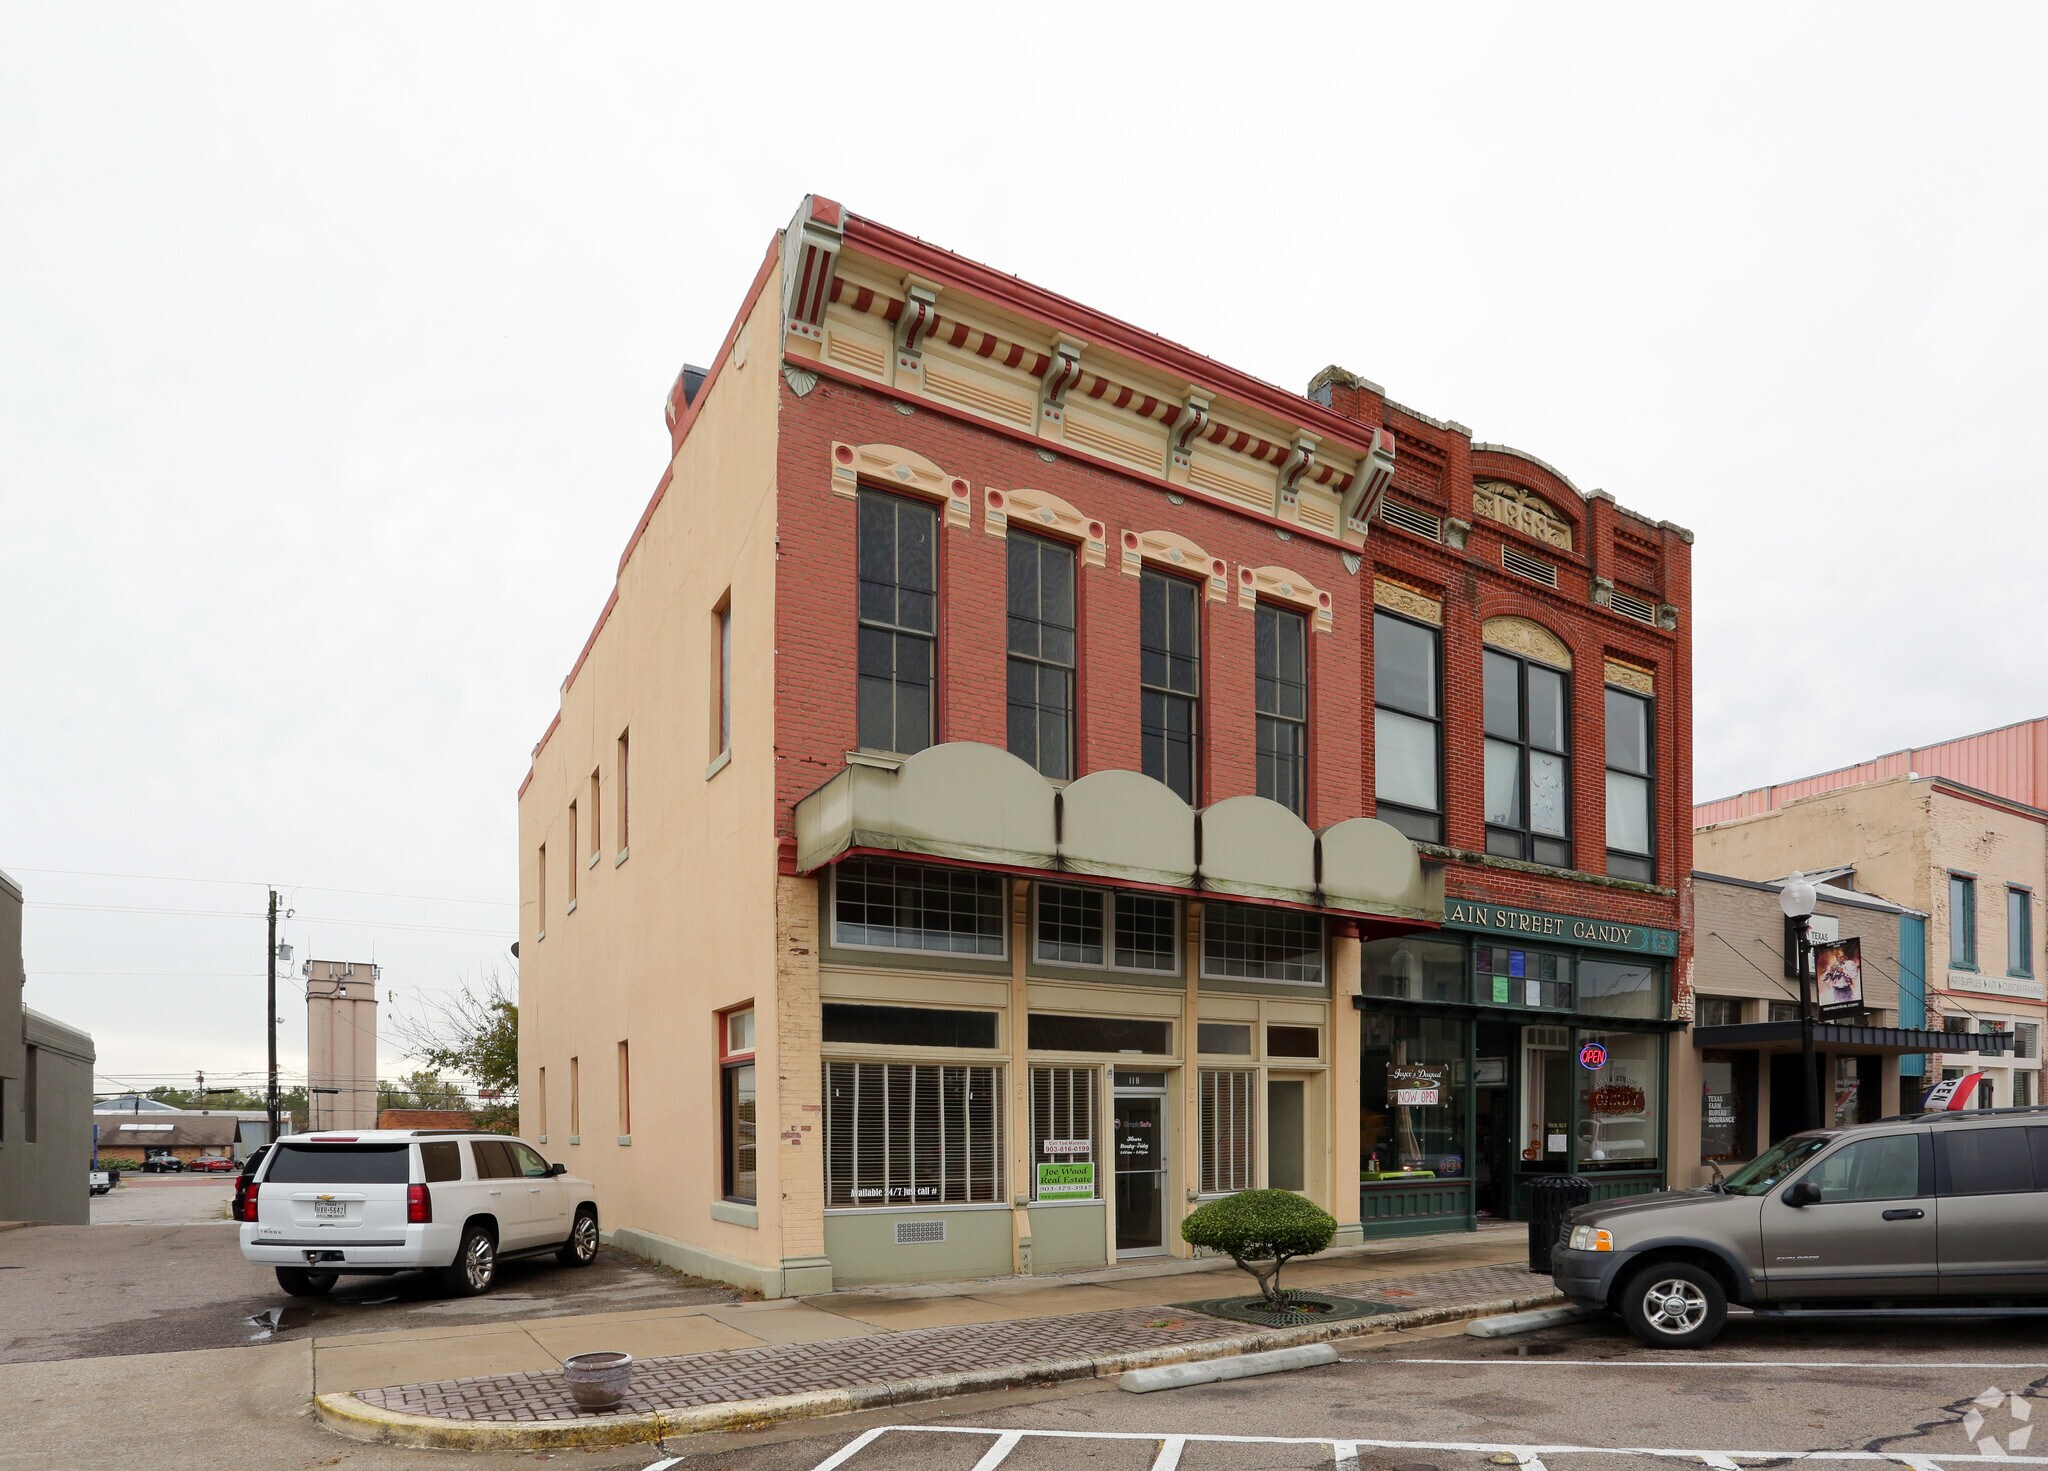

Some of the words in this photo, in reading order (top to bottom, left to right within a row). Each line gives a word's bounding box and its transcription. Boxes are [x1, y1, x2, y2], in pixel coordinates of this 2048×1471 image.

[1444, 903, 1487, 926] AIN
[1495, 911, 1563, 936] STREET
[1573, 921, 1632, 944] CANDY
[1811, 931, 1829, 941] TEXAS
[1961, 977, 1982, 988] SUPPLIES
[1582, 1050, 1604, 1063] OPEN
[1129, 1077, 1140, 1085] 118
[1931, 1081, 1957, 1102] PEN
[1399, 1091, 1417, 1103] NOW
[1421, 1091, 1438, 1103] OPEN
[1061, 1167, 1088, 1175] Wood
[1440, 1162, 1461, 1171] OPEN
[1041, 1175, 1062, 1184] Real
[1064, 1176, 1092, 1184] Estate
[851, 1188, 883, 1197] Available
[885, 1187, 902, 1196] 24/7
[917, 1187, 930, 1195] call
